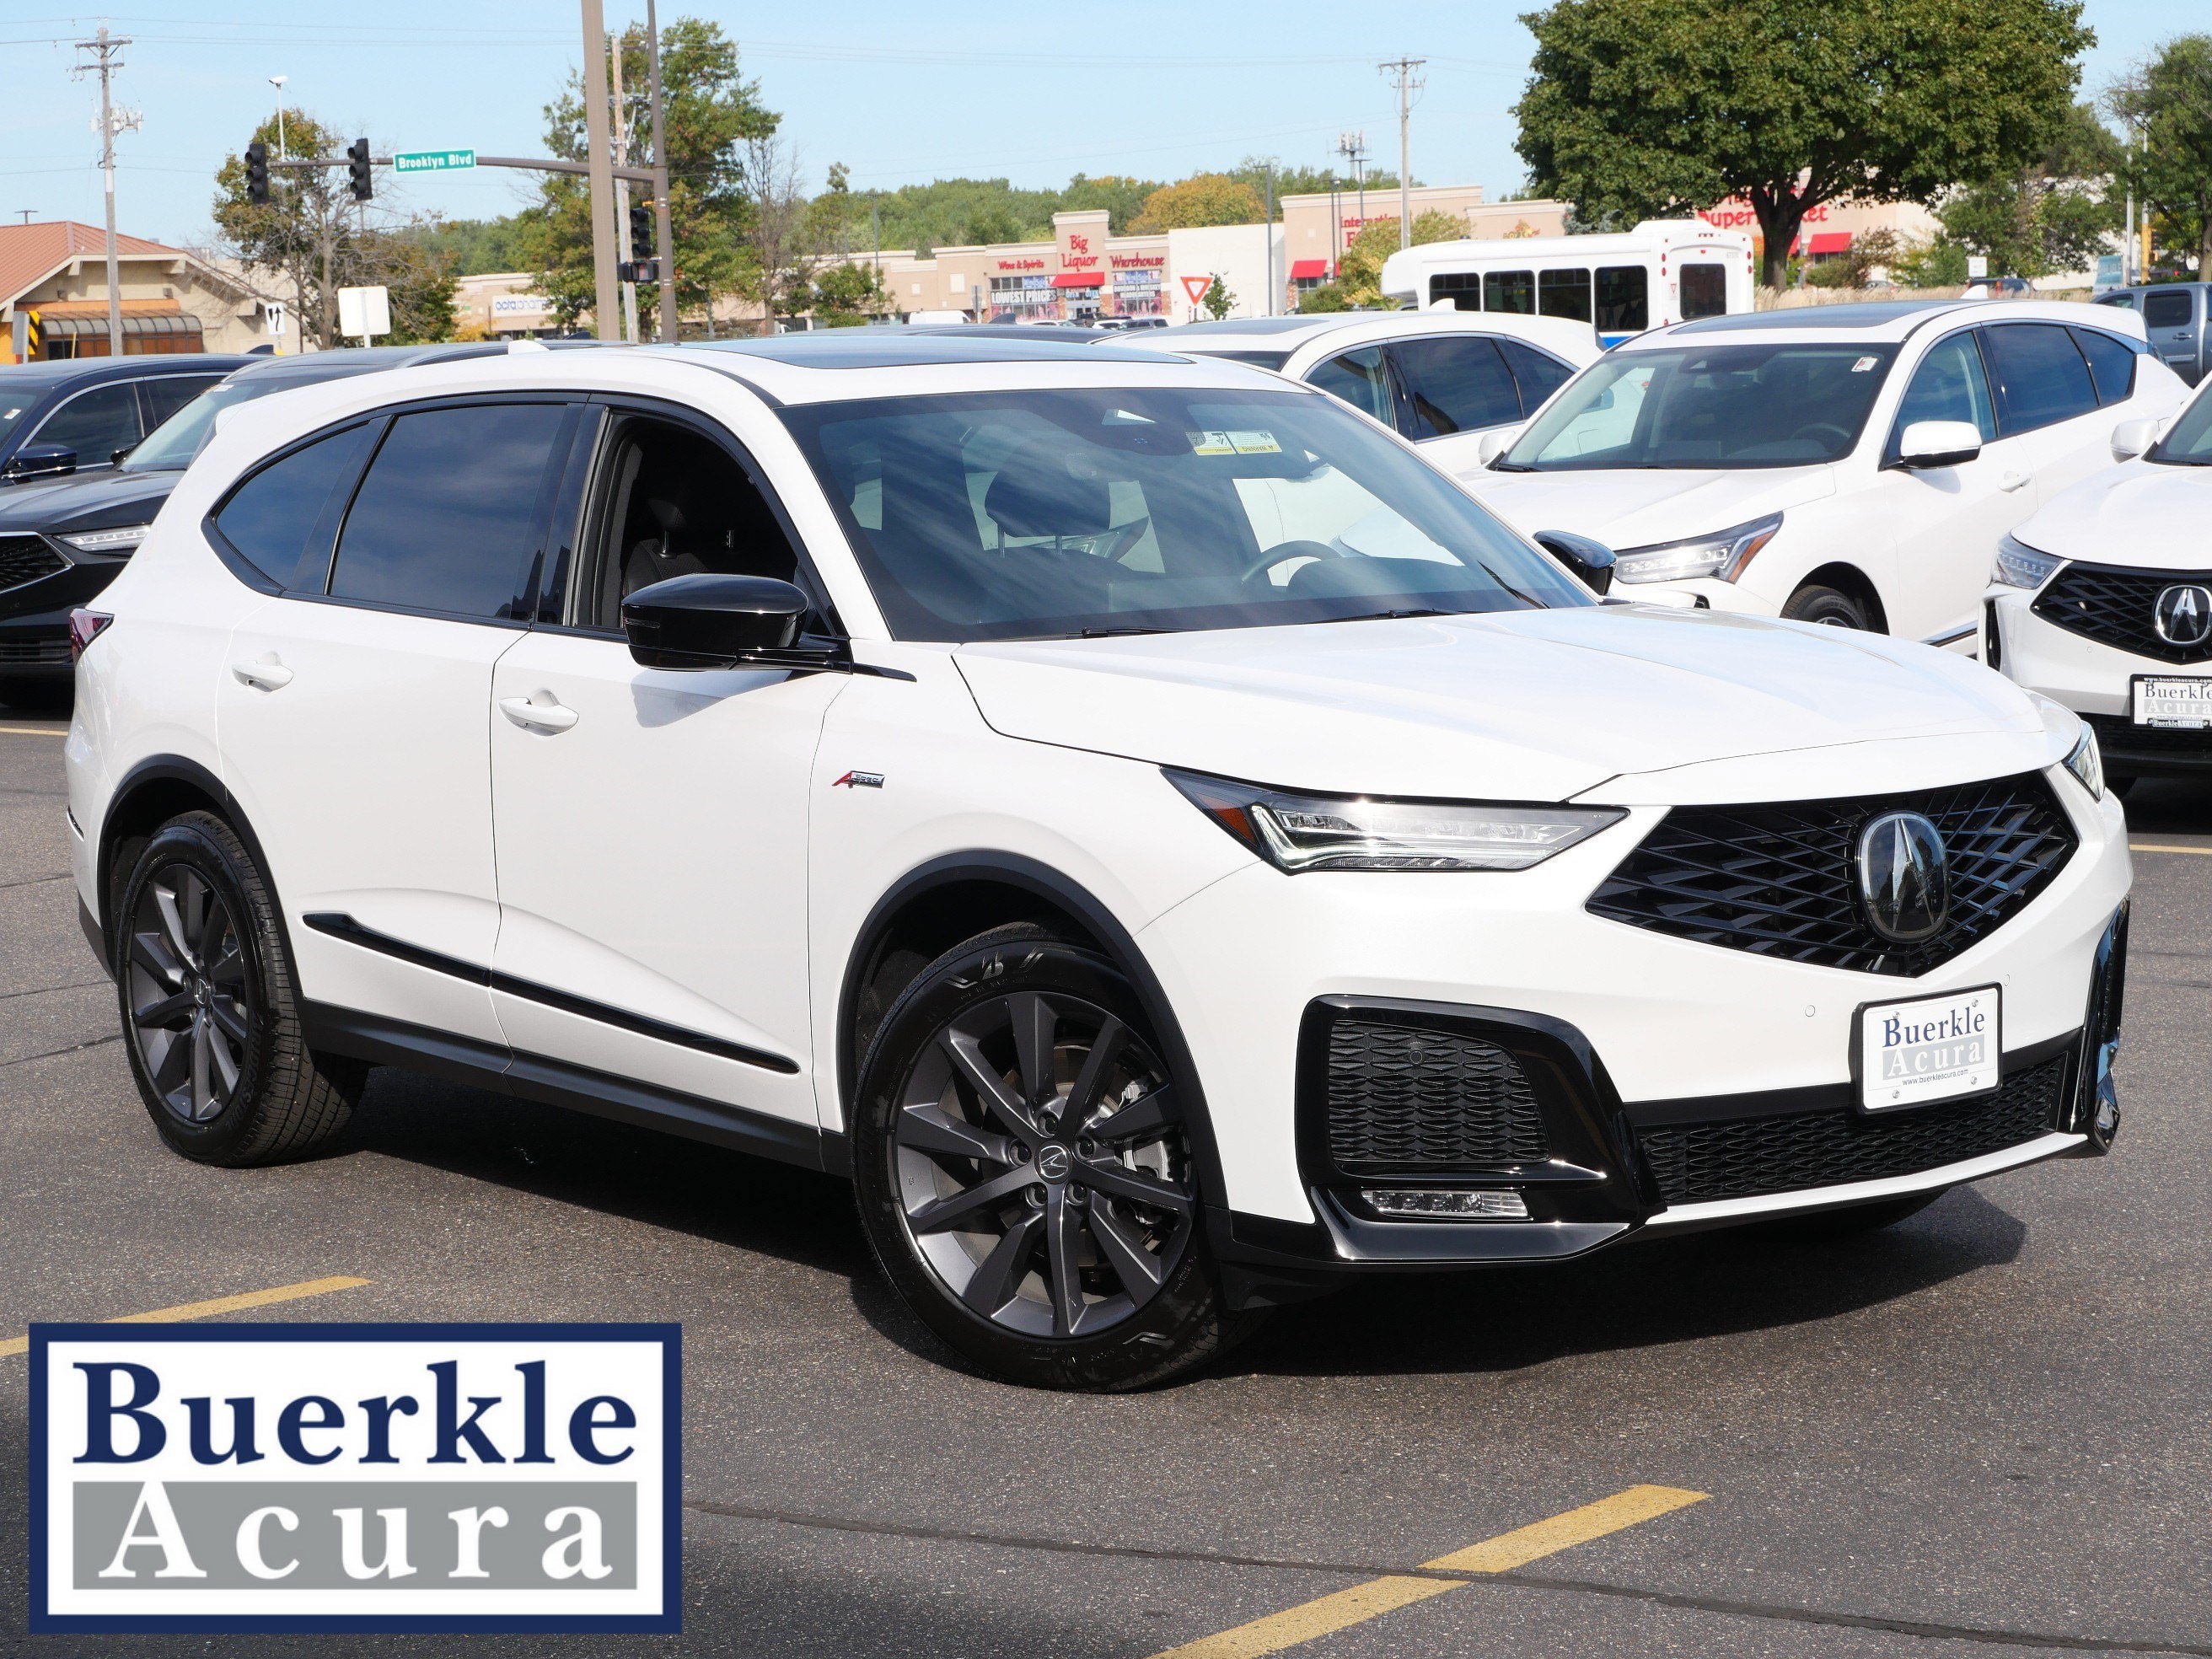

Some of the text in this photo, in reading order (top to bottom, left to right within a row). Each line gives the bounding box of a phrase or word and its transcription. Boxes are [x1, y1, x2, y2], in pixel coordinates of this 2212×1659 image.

[399, 153, 472, 169] Brooklyn Blvd
[1070, 234, 1088, 254] Big
[1016, 260, 1022, 269] &
[1023, 259, 1044, 271] Spirits
[1061, 253, 1098, 271] Liquor
[1109, 252, 1165, 268] Warehouse
[991, 287, 1057, 303] LOWEST PRICES
[2145, 684, 2212, 700] Buerkle
[2147, 699, 2212, 715] Acura
[1882, 1006, 1985, 1047] Buerkle
[1887, 1041, 1983, 1076] Acura
[1902, 1068, 1969, 1086] www.buerkleacura.com
